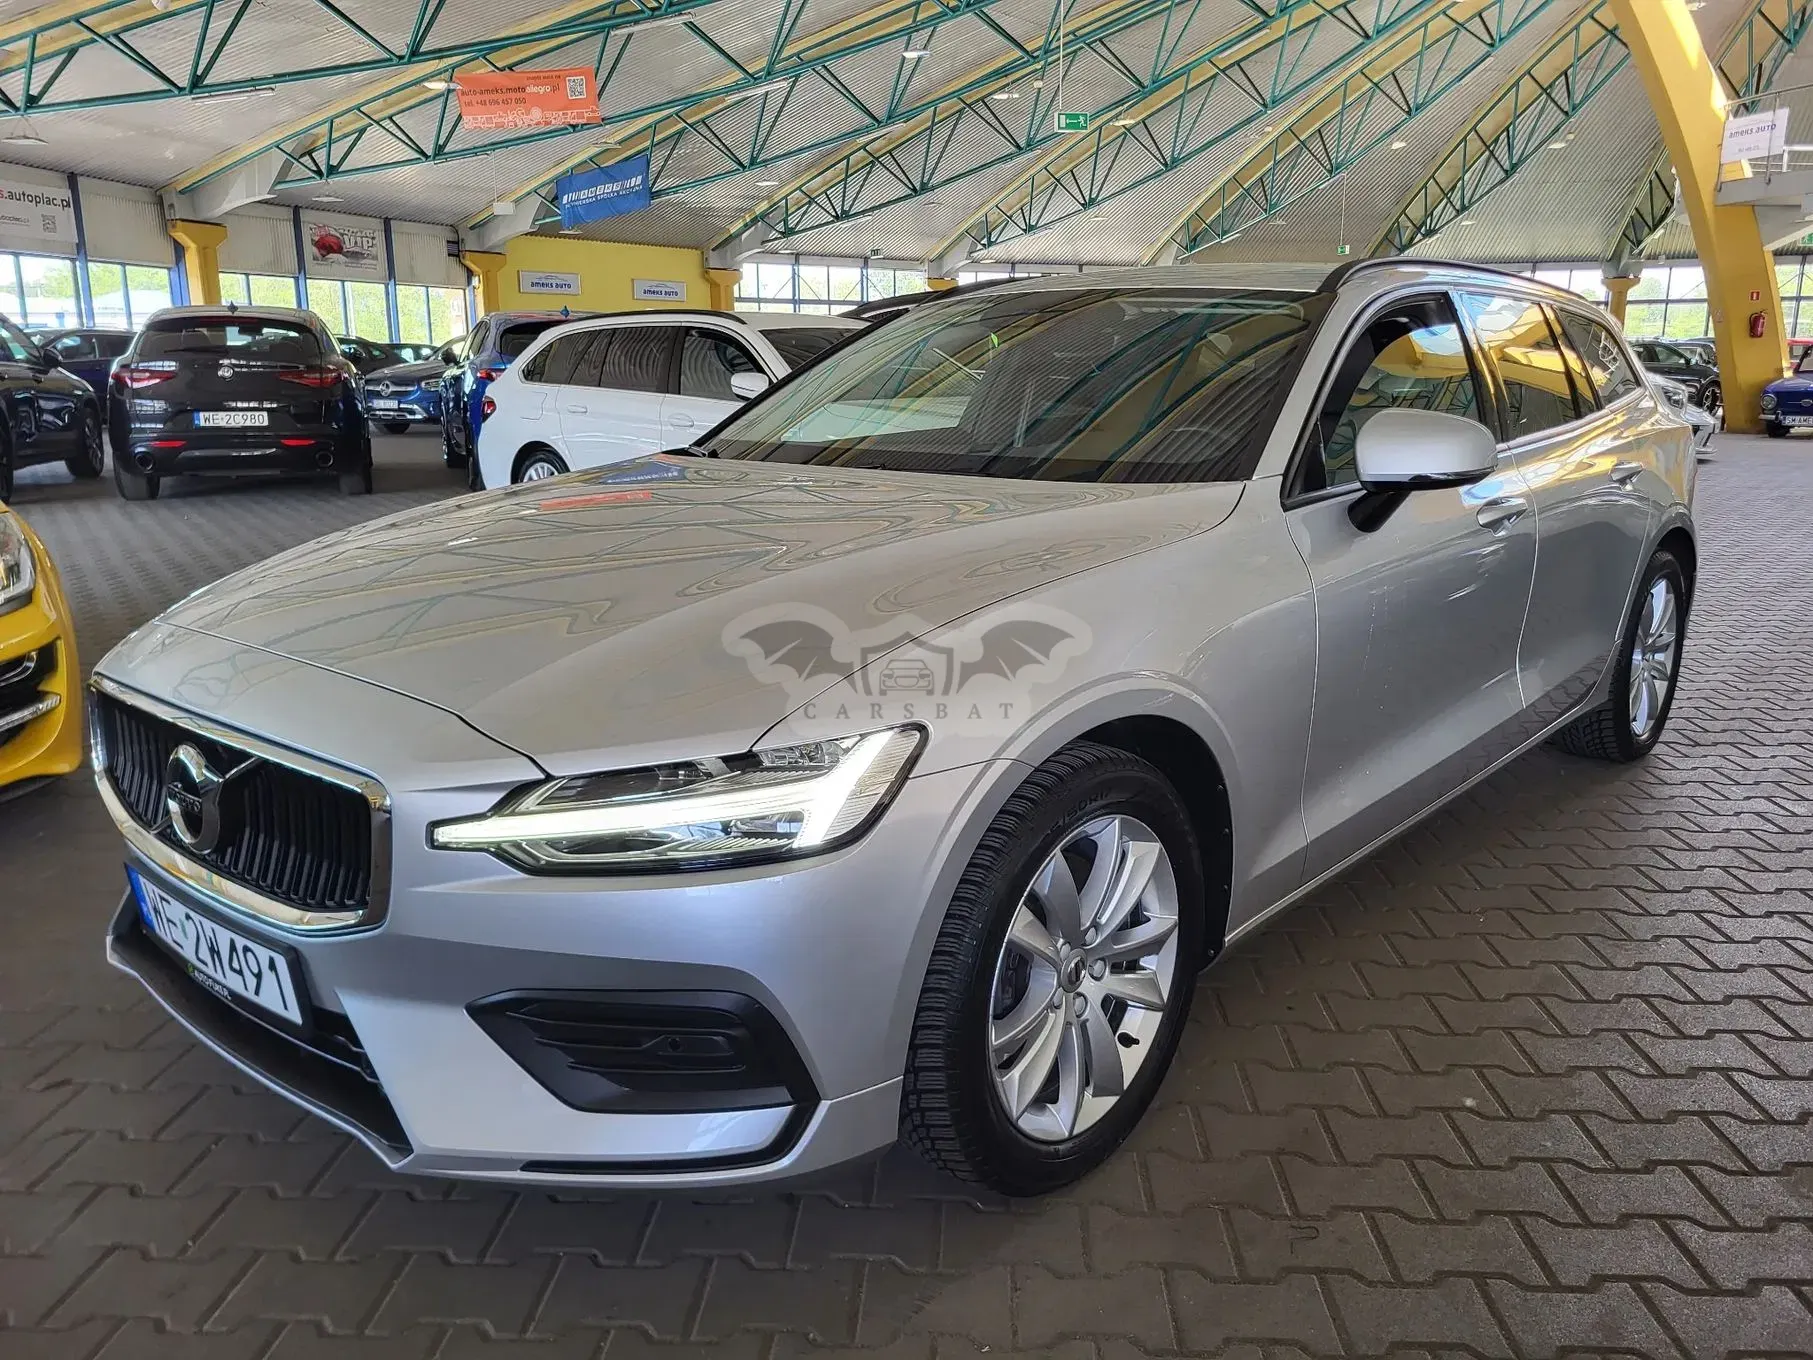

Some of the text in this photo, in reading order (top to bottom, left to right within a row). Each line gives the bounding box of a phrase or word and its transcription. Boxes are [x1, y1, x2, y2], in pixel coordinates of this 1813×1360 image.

[343, 234, 374, 250] VIP
[203, 413, 265, 425] WE 2C980
[143, 879, 290, 1012] WE 2W491
